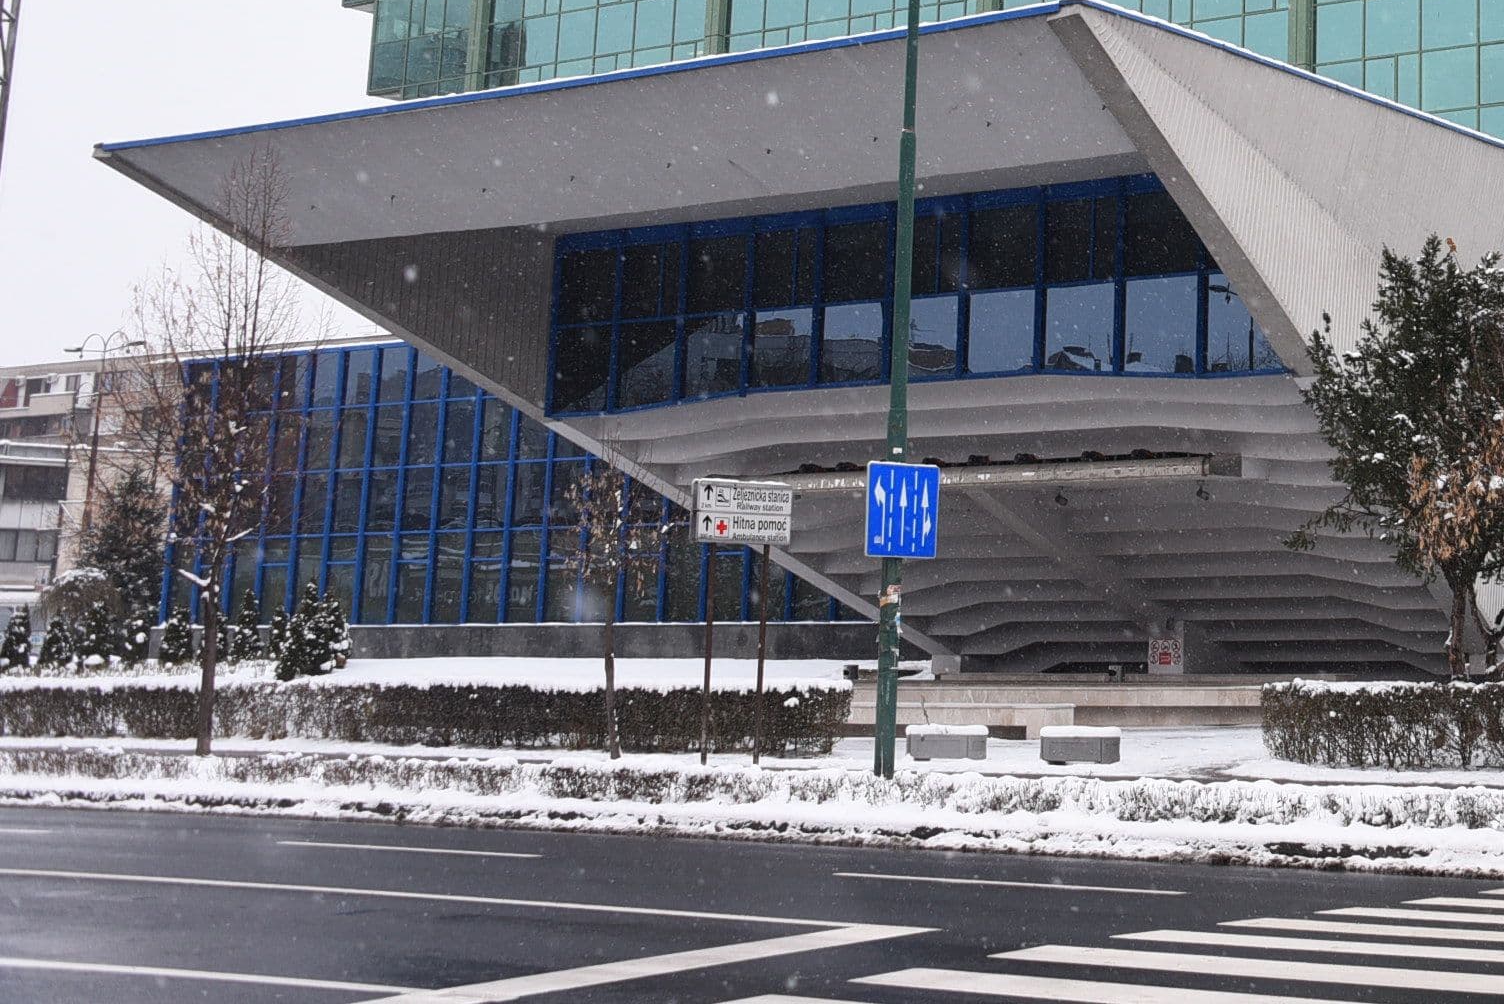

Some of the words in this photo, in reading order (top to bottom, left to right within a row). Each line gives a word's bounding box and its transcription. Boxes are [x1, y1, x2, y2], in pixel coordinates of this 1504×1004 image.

[732, 484, 766, 504] Željeznička
[768, 490, 790, 503] stanica
[737, 503, 760, 511] Railway
[732, 516, 755, 529] Hitna
[758, 517, 787, 533] pomoć
[732, 533, 765, 541] Ambulance
[767, 534, 787, 542] station
